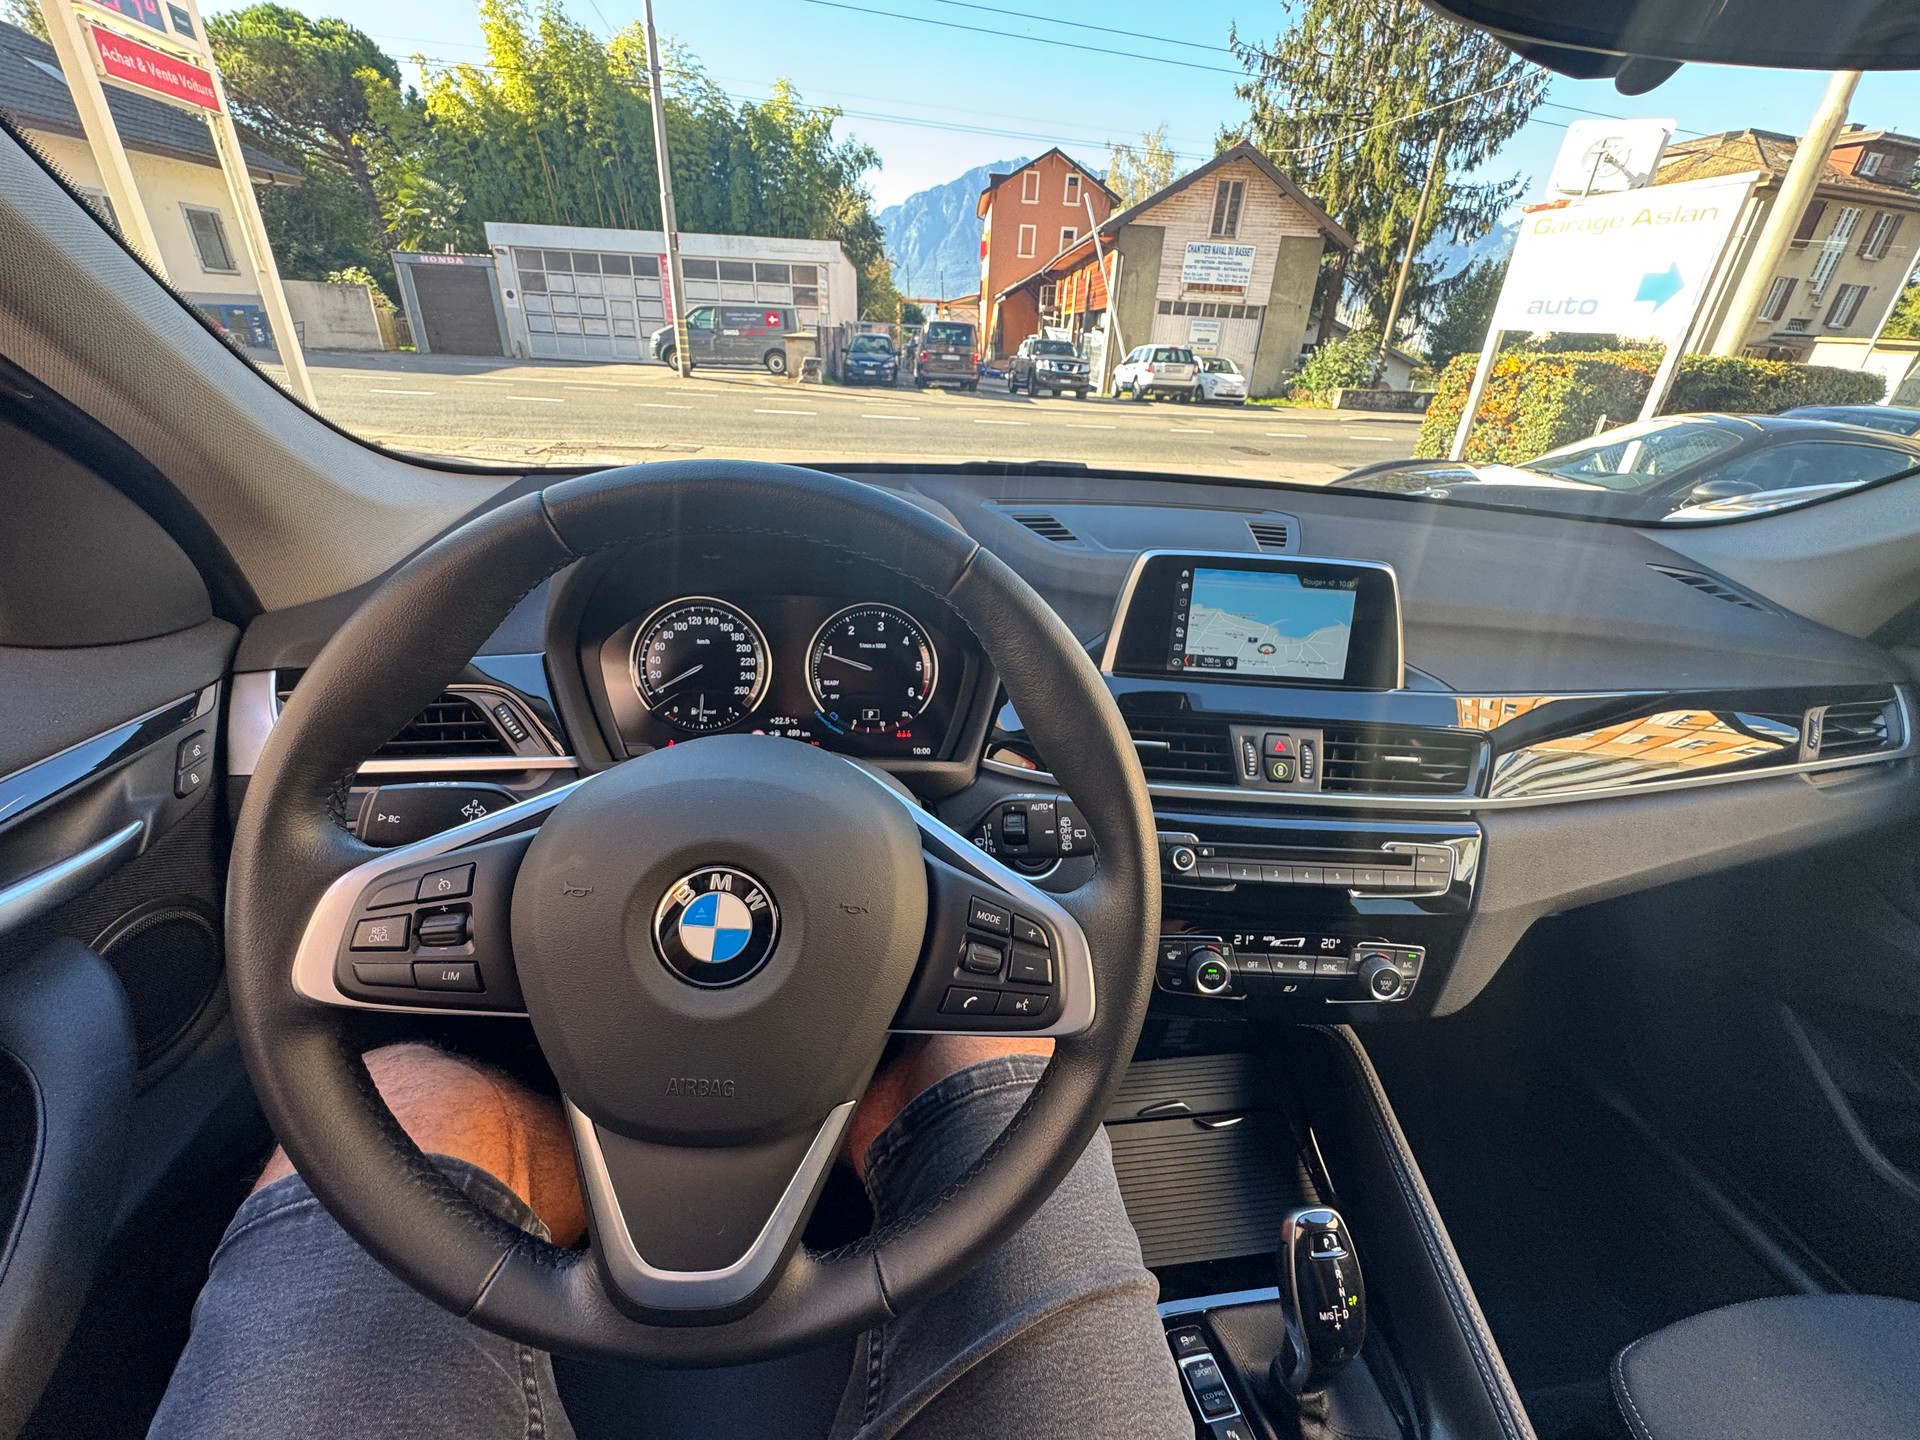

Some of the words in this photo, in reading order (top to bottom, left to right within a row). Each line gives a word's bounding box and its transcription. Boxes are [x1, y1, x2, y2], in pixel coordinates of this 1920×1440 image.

[101, 44, 136, 69] Achat
[138, 57, 148, 73] &
[147, 61, 179, 85] Vente
[178, 72, 214, 98] Voiture
[1533, 214, 1624, 235] Garage
[1631, 206, 1719, 228] Aslan
[1188, 244, 1211, 254] CHANTIER
[1212, 246, 1227, 256] NAVAL
[1228, 246, 1234, 256] DU
[1235, 246, 1254, 257] BASSET
[420, 255, 464, 264] HONDA
[1526, 296, 1598, 316] auto
[688, 617, 702, 625] 120
[704, 617, 719, 625] 140
[673, 622, 688, 630] 100
[720, 624, 734, 632] 160
[848, 626, 855, 635] 2
[877, 622, 884, 631] 3
[663, 631, 674, 639] 80
[731, 633, 744, 641] 180
[902, 636, 909, 645] 4
[655, 643, 665, 651] 60
[736, 644, 751, 652] 200
[828, 646, 833, 655] 1
[915, 662, 922, 671] 5
[734, 687, 750, 695] 260
[908, 687, 914, 697] 6
[1031, 803, 1048, 811] AUTO
[388, 814, 400, 823] BC
[673, 873, 767, 912] BMW
[976, 910, 1001, 925] MODE
[372, 926, 387, 935] RES
[368, 934, 390, 943] CNCL
[1234, 934, 1254, 945] 21°
[1321, 938, 1341, 949] 20°
[442, 971, 460, 981] LIM
[665, 1078, 735, 1097] AIRBAG
[1323, 1238, 1330, 1248] P
[1335, 1270, 1342, 1279] R
[1339, 1287, 1346, 1297] N
[1319, 1312, 1334, 1321] M/S
[1342, 1310, 1349, 1319] D
[1195, 1366, 1212, 1378] SPORT
[1202, 1392, 1214, 1401] ECO
[1214, 1390, 1226, 1398] PRO
